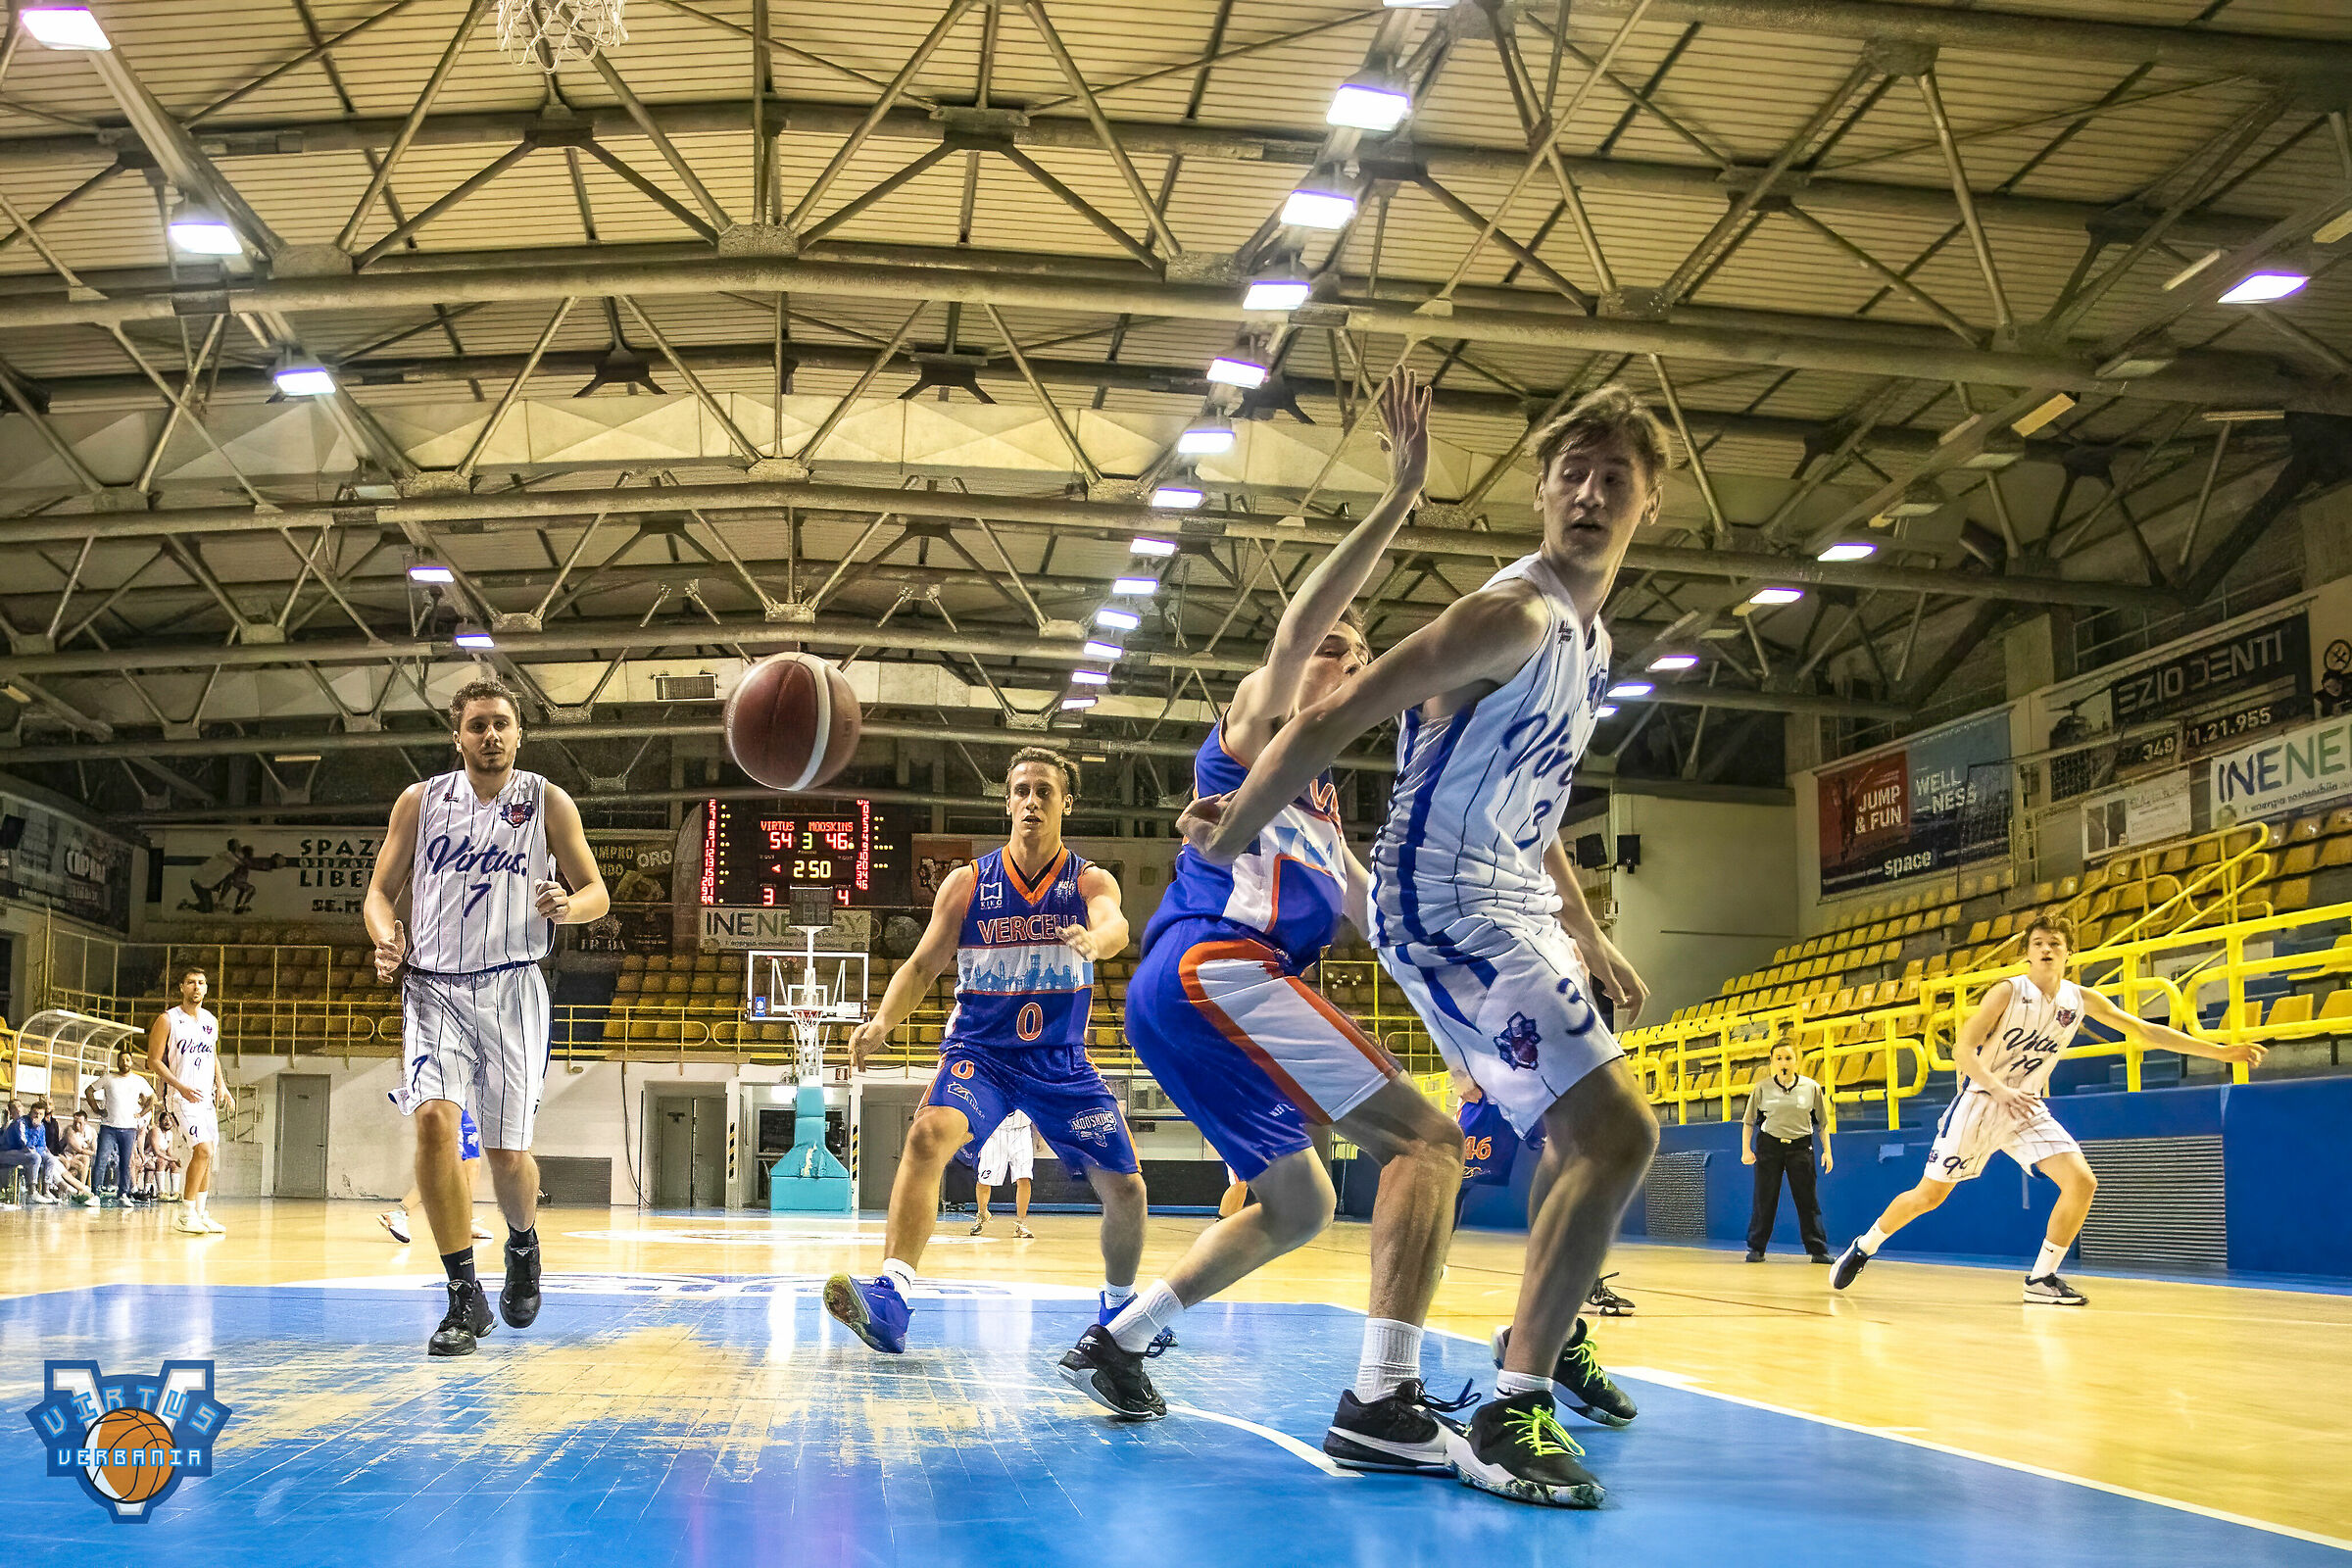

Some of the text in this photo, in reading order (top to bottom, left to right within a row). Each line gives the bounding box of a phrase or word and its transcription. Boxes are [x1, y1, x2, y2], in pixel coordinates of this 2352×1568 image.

[2118, 666, 2184, 714] EZIO
[2218, 723, 2352, 804] INENE
[1916, 767, 1963, 796] WELL
[1859, 785, 1901, 812] JUMP
[1932, 782, 1978, 814] NESS
[760, 821, 795, 831] VIRTUS
[808, 821, 854, 832] MOOSKINS
[1513, 800, 1552, 851] 3
[1870, 806, 1902, 831] FUN
[300, 839, 383, 856] SPAZ
[769, 832, 793, 850] 54
[802, 832, 813, 850] 3
[825, 833, 848, 850] 46
[637, 850, 672, 867] ORO
[1884, 851, 1932, 878] space
[300, 870, 373, 887] LIBE
[463, 882, 492, 917] 7
[763, 888, 774, 906] 3
[837, 889, 850, 906] 4
[1016, 1002, 1044, 1042] 0
[951, 1060, 974, 1079] 0
[1465, 1135, 1492, 1160] 46
